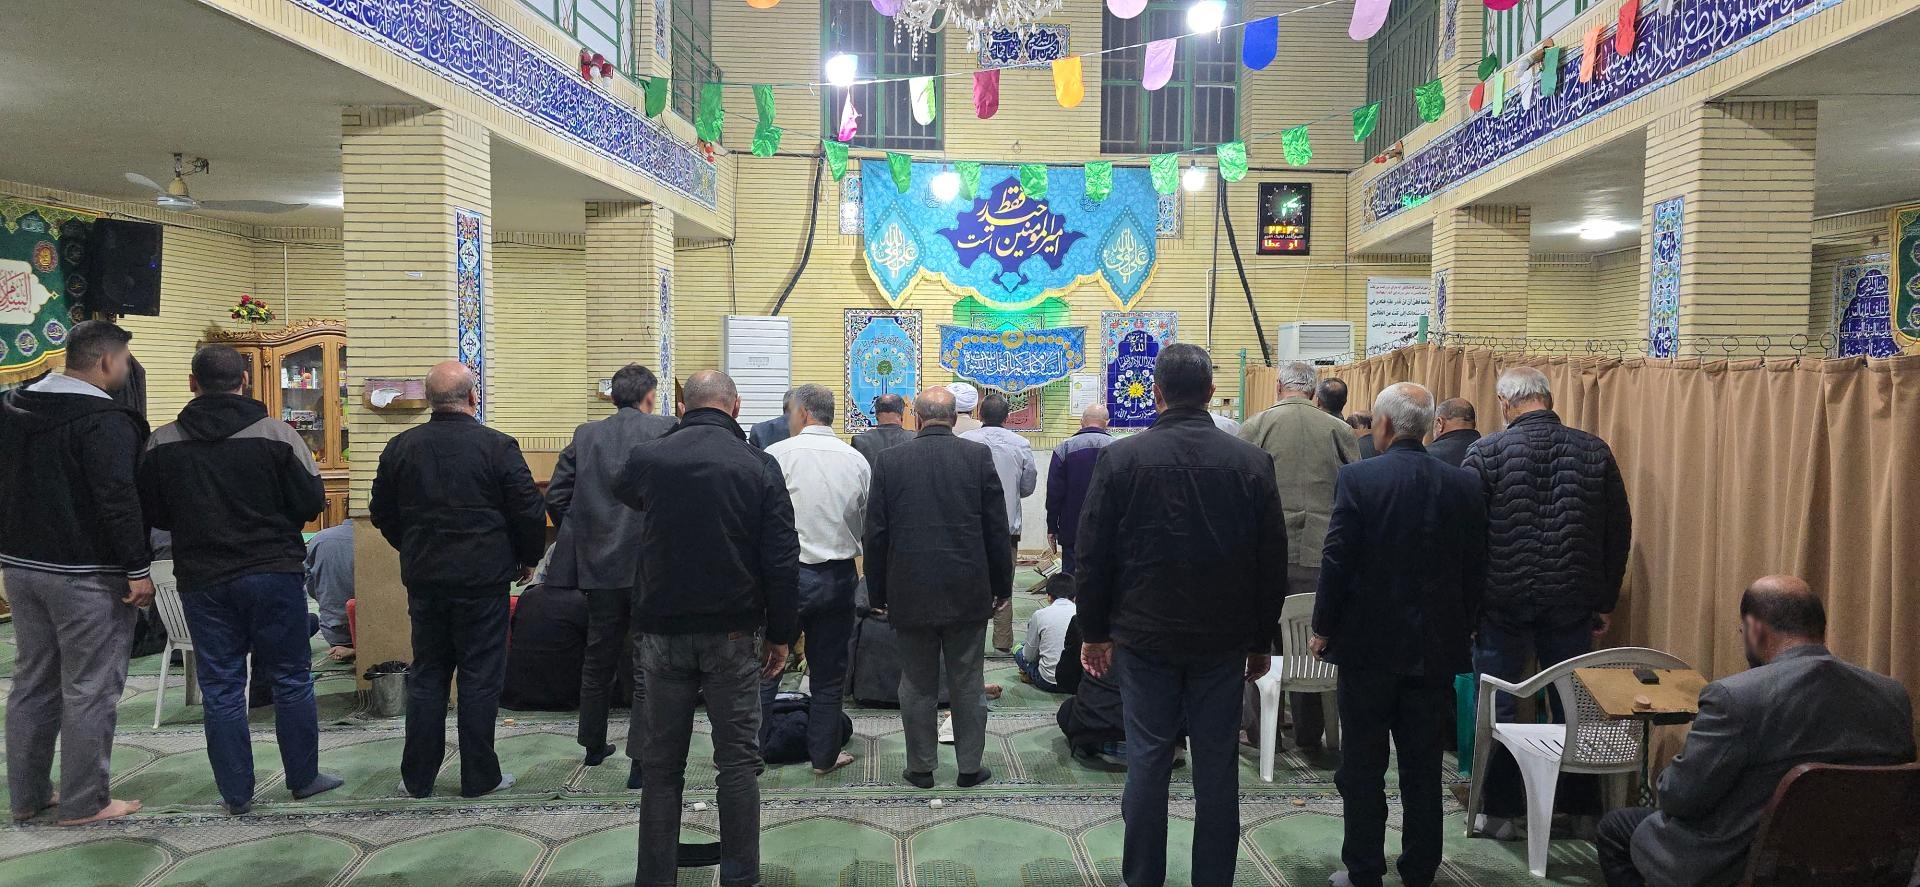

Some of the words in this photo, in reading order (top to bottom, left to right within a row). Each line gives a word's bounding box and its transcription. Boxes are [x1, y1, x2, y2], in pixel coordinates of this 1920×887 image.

[994, 185, 1026, 213] فقط
[976, 201, 1048, 229] حیدر
[957, 233, 993, 252] است
